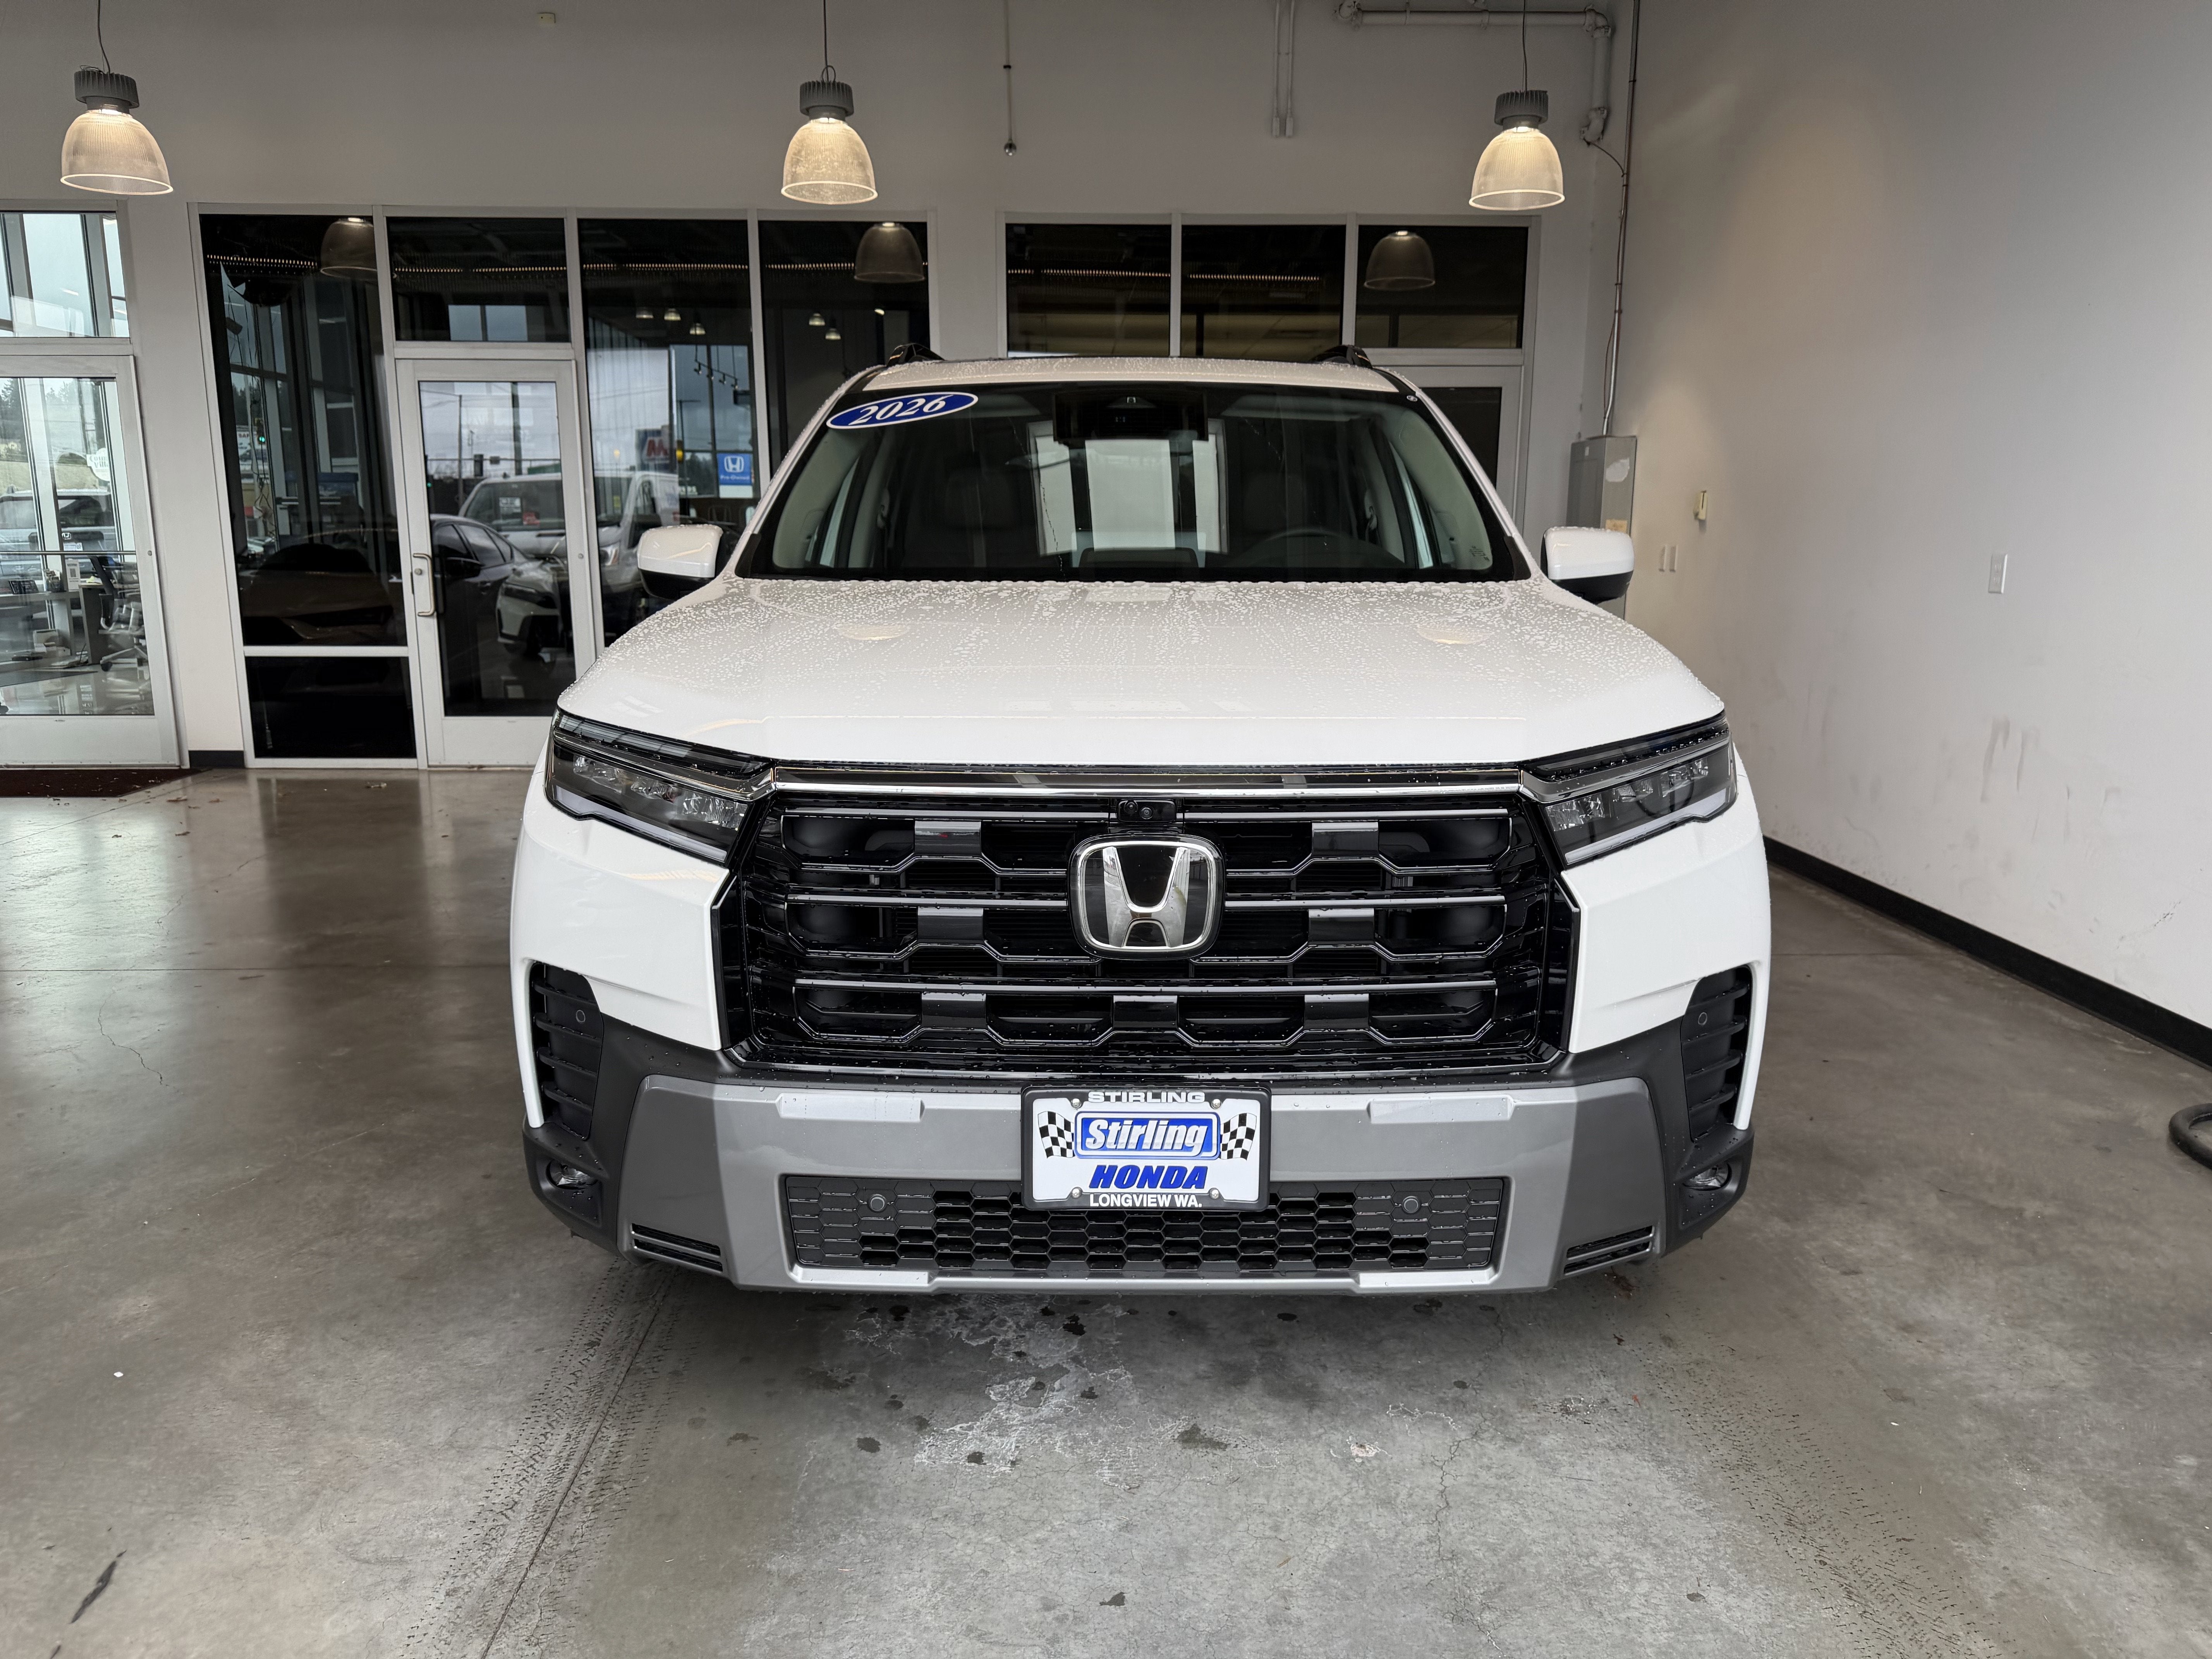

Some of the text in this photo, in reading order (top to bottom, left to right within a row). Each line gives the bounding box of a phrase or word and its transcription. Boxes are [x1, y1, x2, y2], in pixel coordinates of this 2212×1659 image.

[848, 394, 954, 426] 2026
[1088, 1091, 1205, 1103] STIRLING
[1085, 1119, 1207, 1156] Stirling
[1089, 1164, 1208, 1189] HONDA
[1089, 1194, 1202, 1207] LONGVIEW WA.
